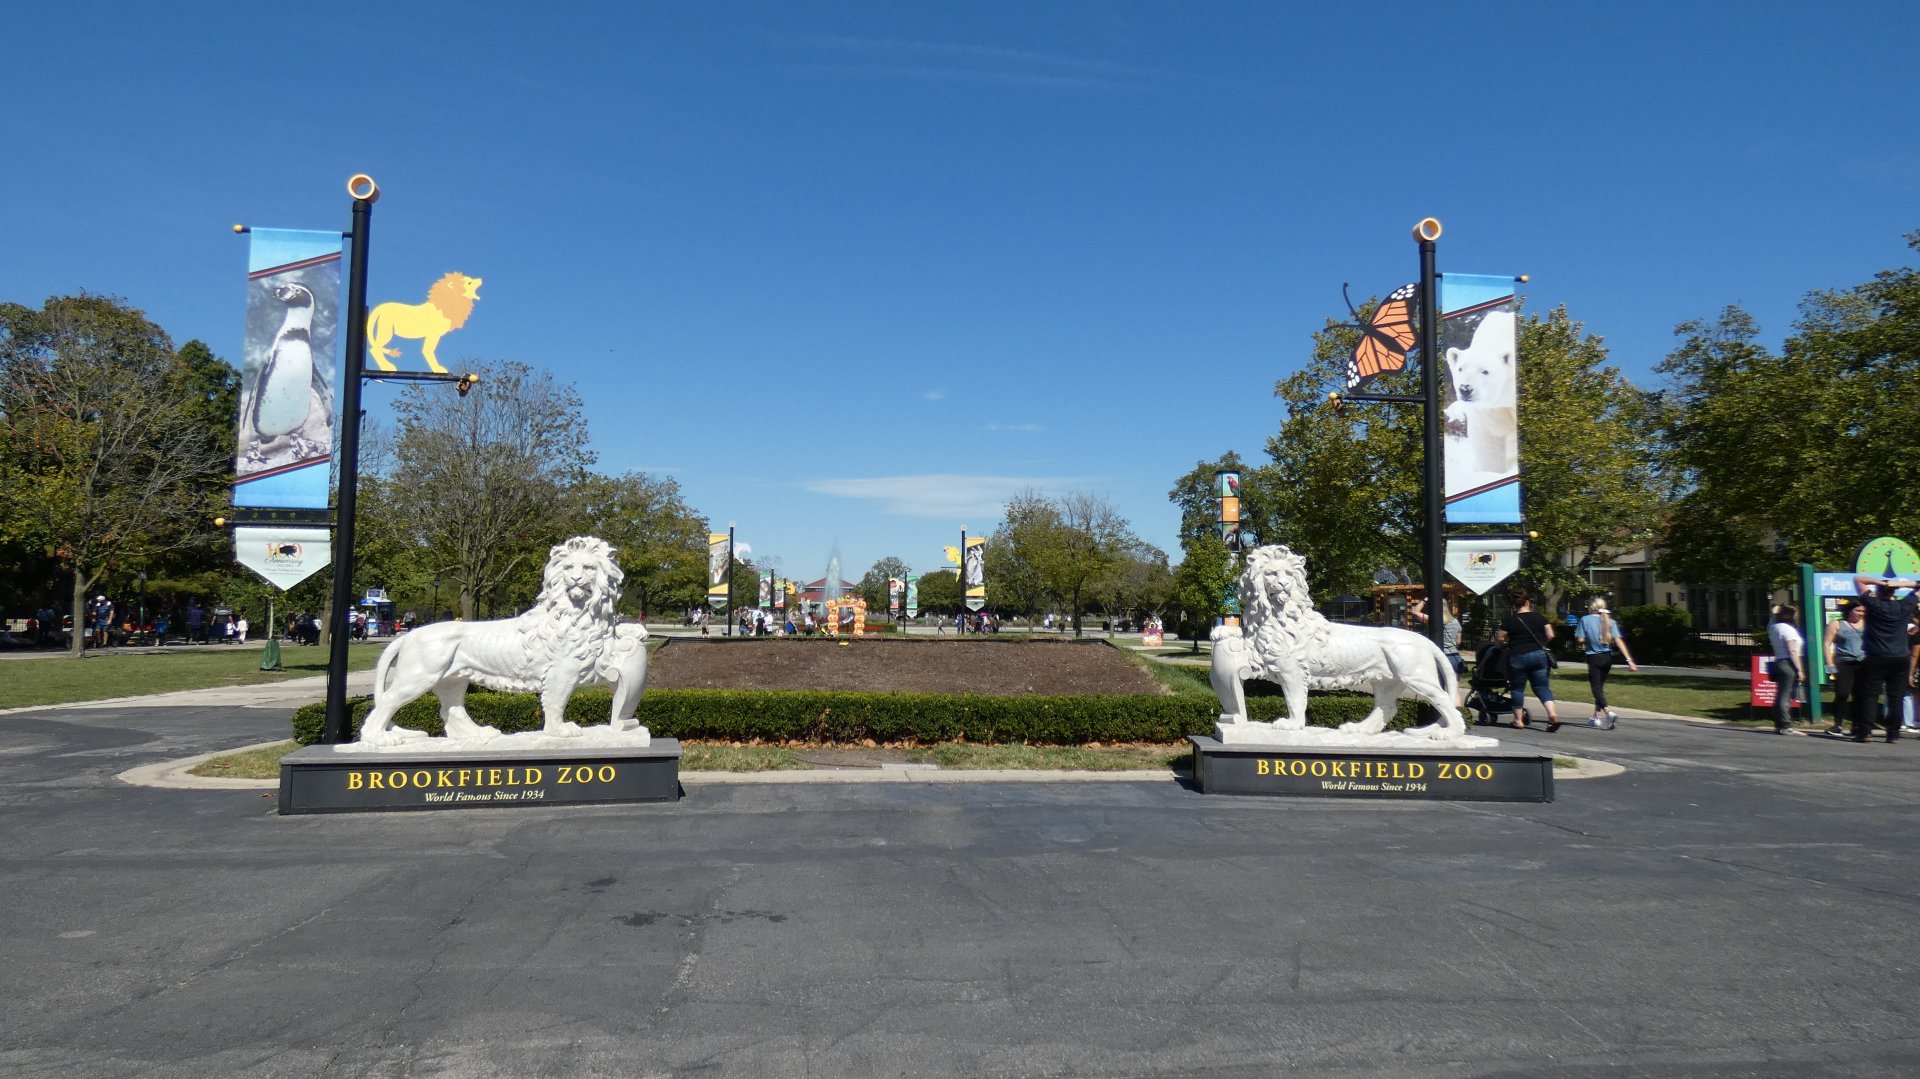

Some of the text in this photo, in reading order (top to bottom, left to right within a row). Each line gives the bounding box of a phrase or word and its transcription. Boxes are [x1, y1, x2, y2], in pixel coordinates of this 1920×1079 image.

[1820, 576, 1852, 591] Plan
[1256, 759, 1493, 780] BROOKFIELD ZOO
[347, 765, 616, 790] BROOKFIELD ZOO
[1321, 780, 1427, 792] World Famous Since 1934
[424, 790, 545, 803] World Famous Since 1934
